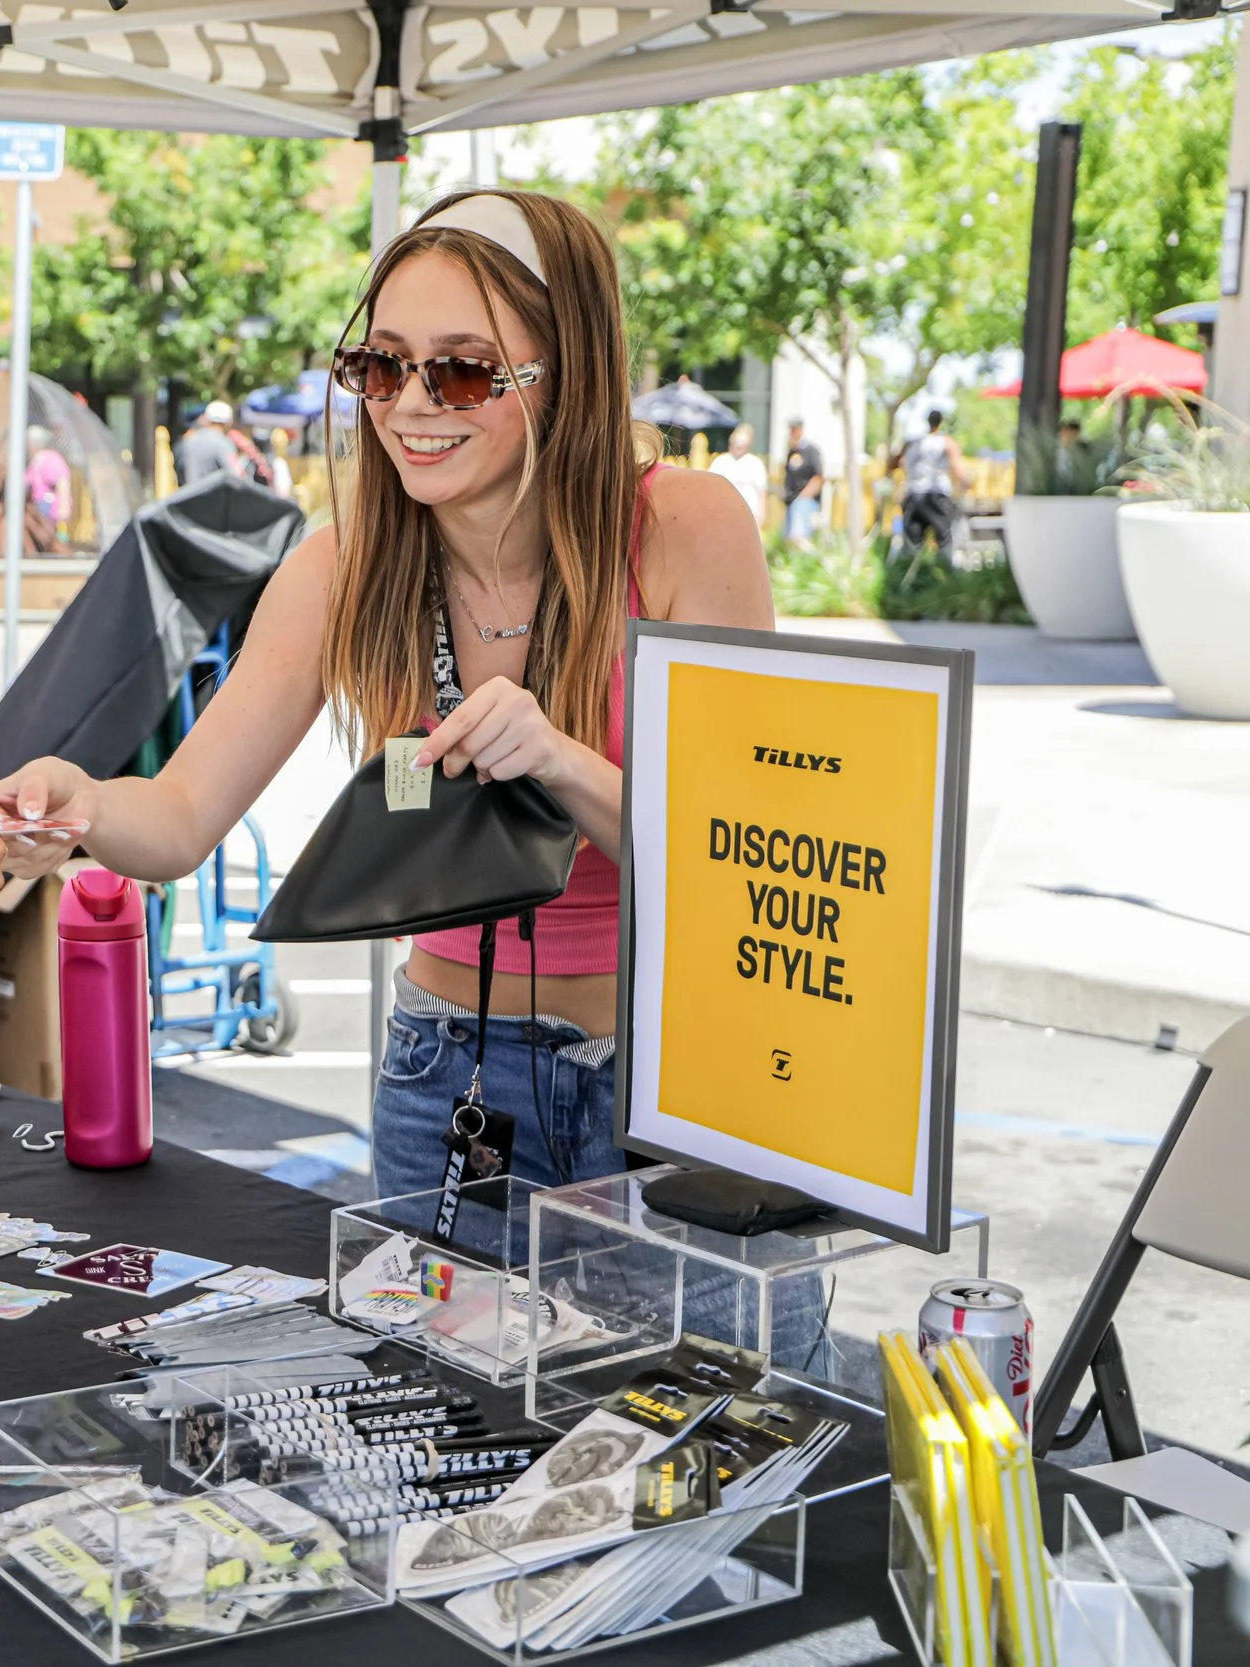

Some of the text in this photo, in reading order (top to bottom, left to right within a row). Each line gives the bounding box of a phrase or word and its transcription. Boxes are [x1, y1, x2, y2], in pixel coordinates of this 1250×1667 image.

[753, 746, 842, 774] TiLLYS
[709, 817, 886, 895] DISCOVER
[746, 880, 841, 943] YOUR
[736, 935, 853, 1005] STYLE.
[85, 1267, 106, 1275] SINK
[1007, 1335, 1024, 1380] Diet
